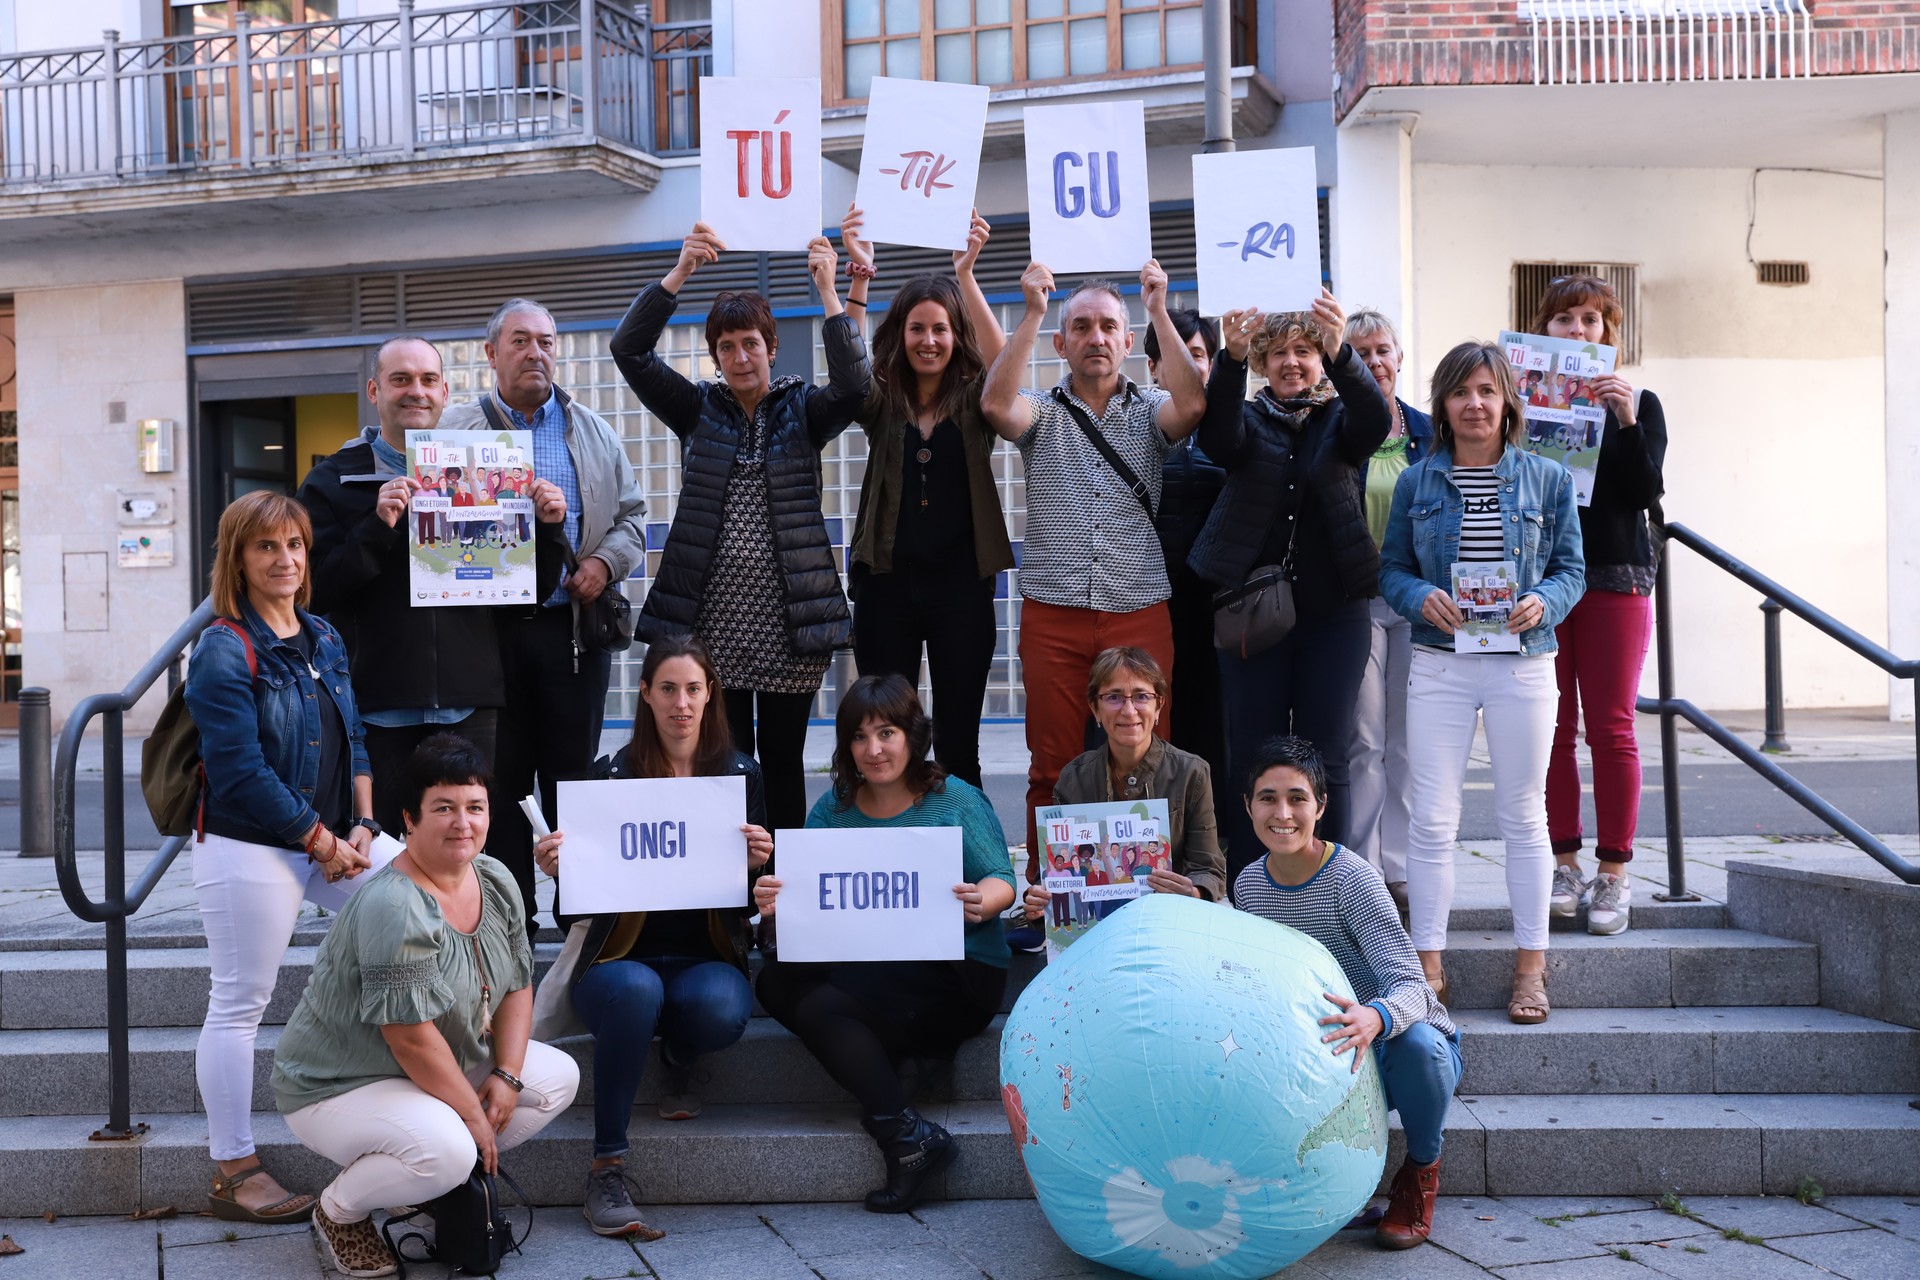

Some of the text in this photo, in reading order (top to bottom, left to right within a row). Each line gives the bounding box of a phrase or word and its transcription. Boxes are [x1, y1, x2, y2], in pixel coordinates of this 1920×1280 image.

[726, 110, 792, 199] TÚ
[1052, 151, 1119, 219] GU
[1216, 221, 1295, 262] -RA
[1510, 346, 1525, 365] TÚ
[1565, 355, 1581, 372] GU
[421, 443, 437, 464] TÚ
[481, 447, 498, 463] GU
[620, 821, 687, 860] ONGI
[1052, 819, 1070, 842] TÚ
[1114, 820, 1133, 839] GU
[819, 871, 920, 911] ETORRI
[1048, 879, 1083, 888] ONGI ETORRI
